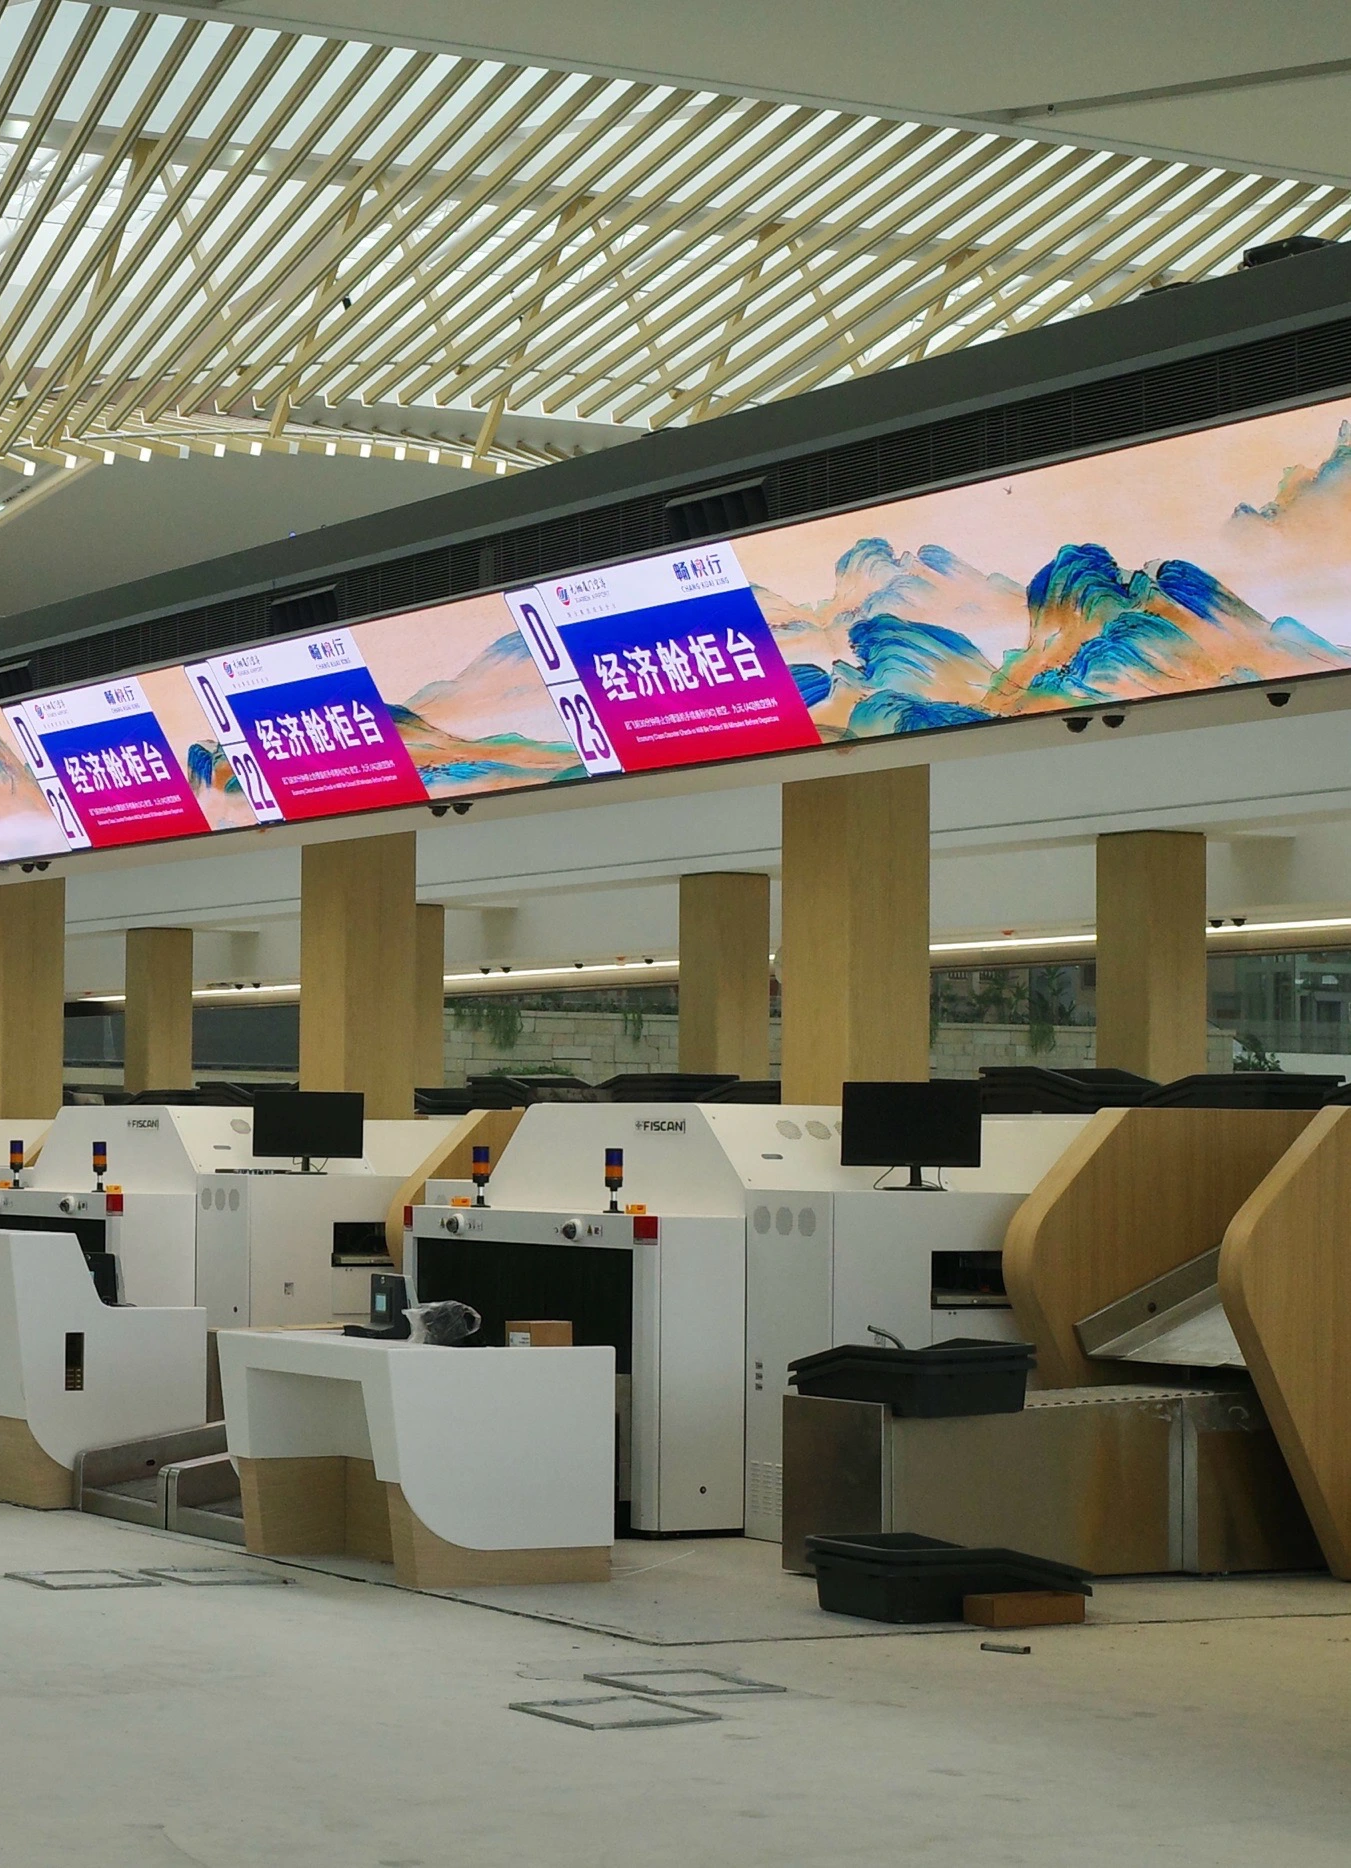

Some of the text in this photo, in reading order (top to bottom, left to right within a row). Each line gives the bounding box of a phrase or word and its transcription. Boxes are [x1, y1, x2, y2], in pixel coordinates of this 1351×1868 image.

[519, 603, 561, 671] D
[592, 627, 766, 703] 经济舱柜台
[197, 676, 230, 732] D
[255, 700, 384, 761] 经济舱柜台
[559, 694, 611, 760] 23
[13, 717, 44, 768] D
[63, 741, 171, 794] 经济舱柜台
[232, 753, 276, 810] 22
[46, 786, 84, 839] 21
[132, 1120, 157, 1128] FISCAN
[643, 1121, 683, 1131] FISCAN
